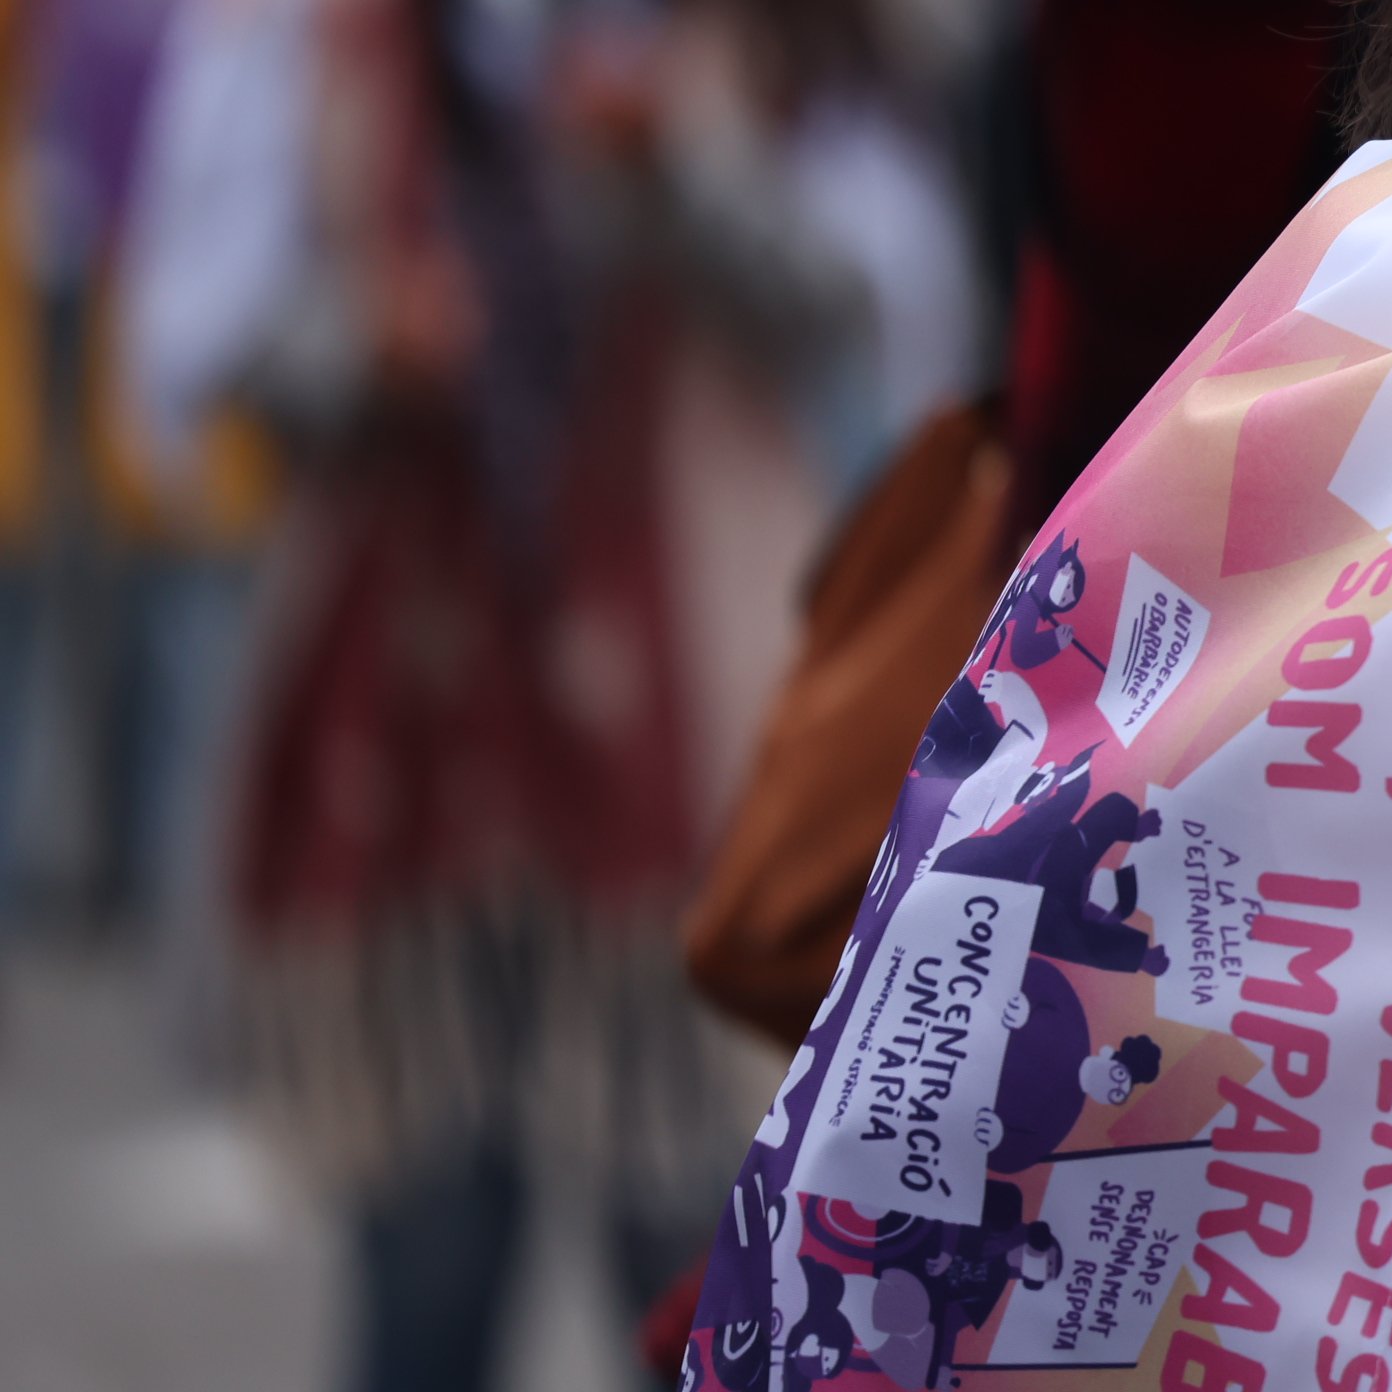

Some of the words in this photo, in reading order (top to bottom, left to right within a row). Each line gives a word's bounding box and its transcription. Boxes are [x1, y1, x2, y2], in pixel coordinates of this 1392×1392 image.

[1124, 598, 1194, 727] AUTODEFENSA
[1218, 847, 1241, 868] A
[1215, 879, 1236, 906] LA
[1219, 925, 1243, 978] LLEI
[1088, 1180, 1125, 1244] SENSE
[1088, 1189, 1155, 1339] DESNONAMENT
[1138, 1242, 1170, 1286] CAP
[1052, 1259, 1098, 1350] RESPOSTA
